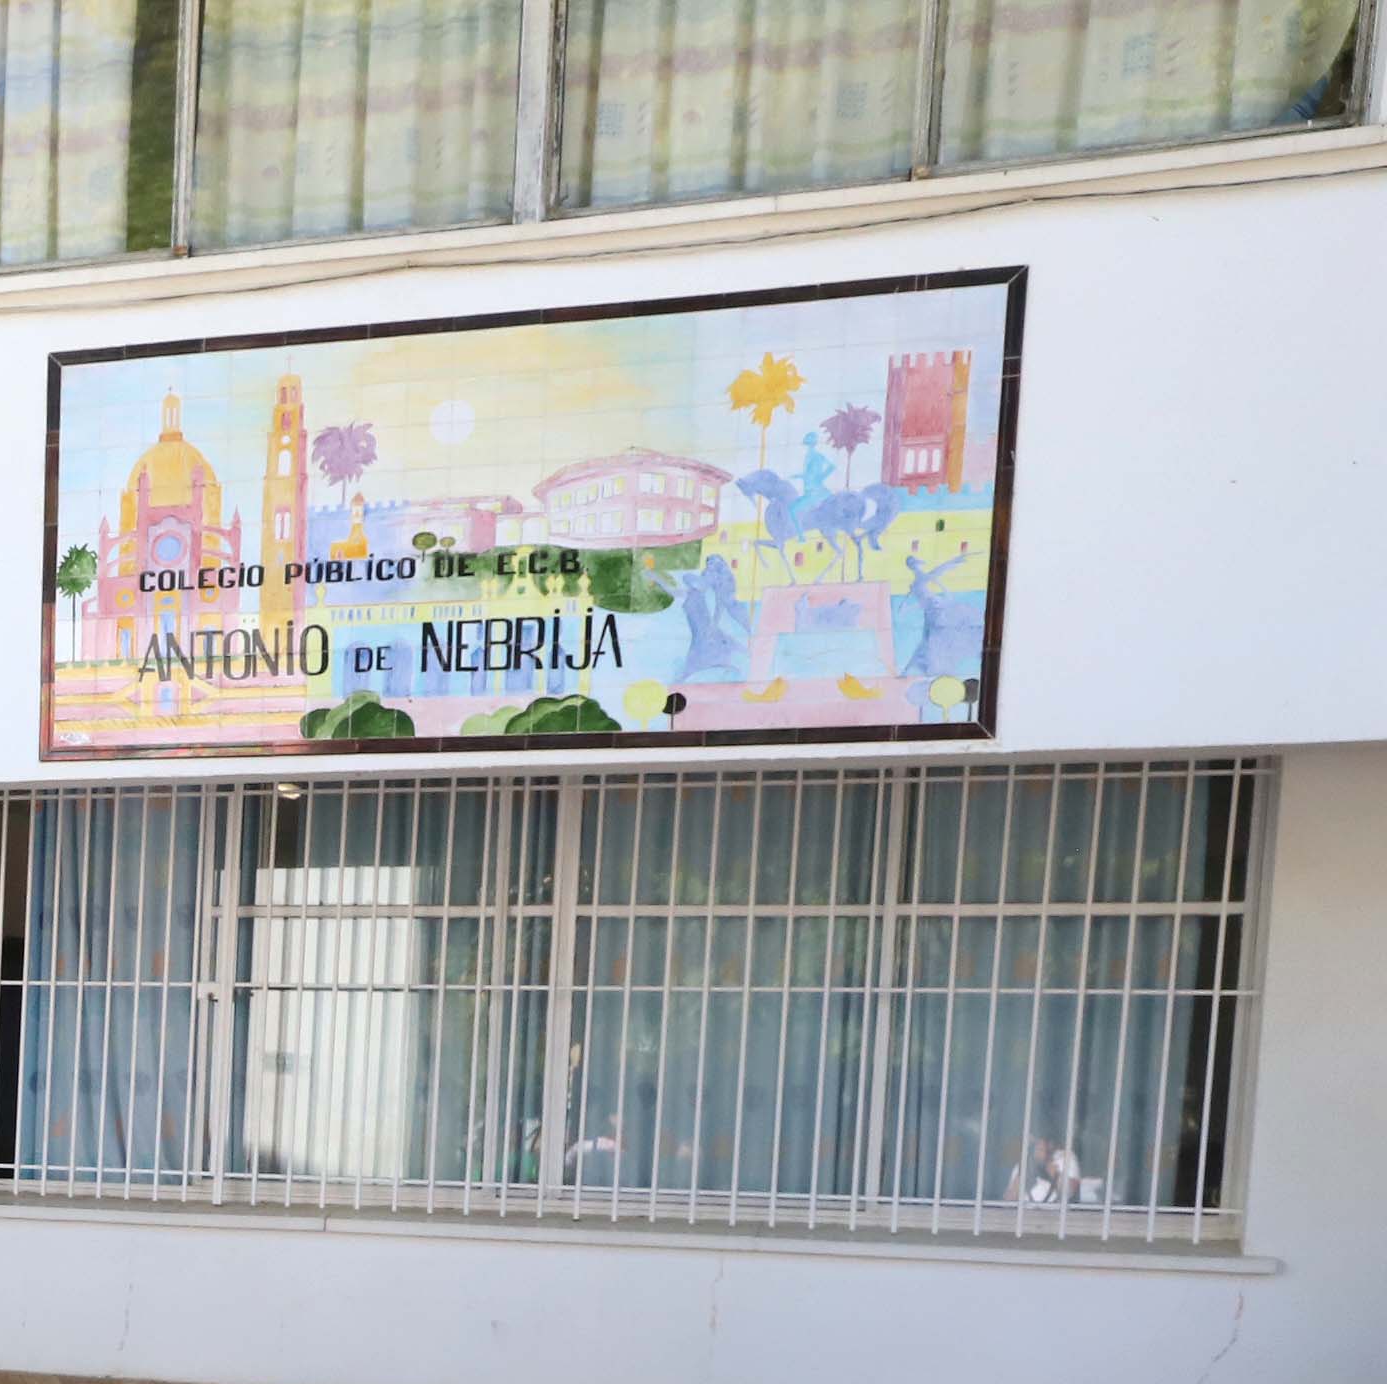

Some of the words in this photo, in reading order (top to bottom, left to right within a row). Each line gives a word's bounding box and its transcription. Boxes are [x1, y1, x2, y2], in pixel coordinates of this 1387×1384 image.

[139, 562, 265, 593] COLEGIO
[284, 553, 416, 586] PÚBLICO
[433, 551, 477, 579] DE
[138, 620, 330, 682] ANTONIO
[354, 645, 393, 673] DE
[421, 608, 623, 673] NEBRIJA
